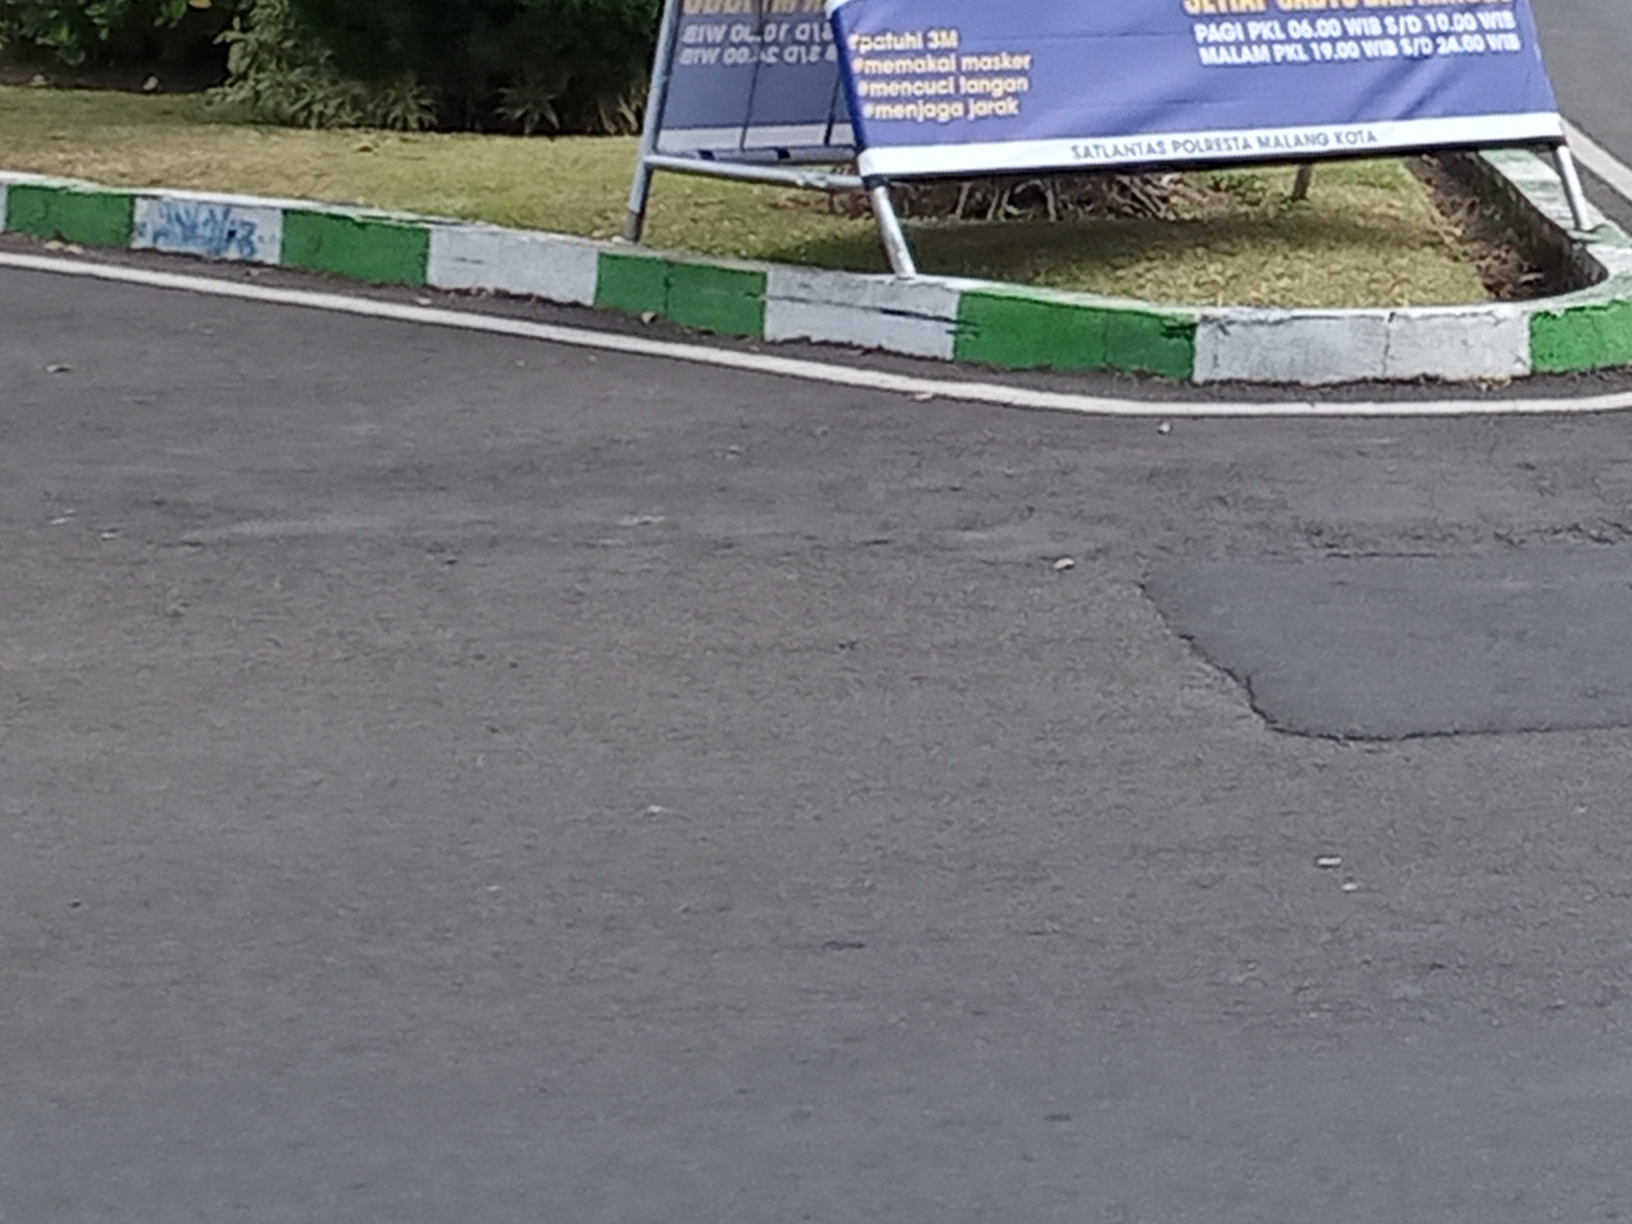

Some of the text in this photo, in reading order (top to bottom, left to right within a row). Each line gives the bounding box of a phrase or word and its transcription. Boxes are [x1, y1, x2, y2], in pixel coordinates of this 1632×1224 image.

[1193, 10, 1516, 44] PAGI PKL 06.00 WIB S/D 10.00 WIB
[848, 29, 959, 54] #patuhi 3M
[1198, 32, 1523, 67] MALAM PKL 19.00 WIB S/D 24.00 WIB
[853, 54, 956, 74] #memakai
[961, 51, 1033, 71] masker
[857, 76, 1030, 98] #mencuci tangan
[862, 96, 1020, 122] #menjaga jarak
[1070, 129, 1379, 161] SATLANTAS POLRESTA MALANG KOTA
